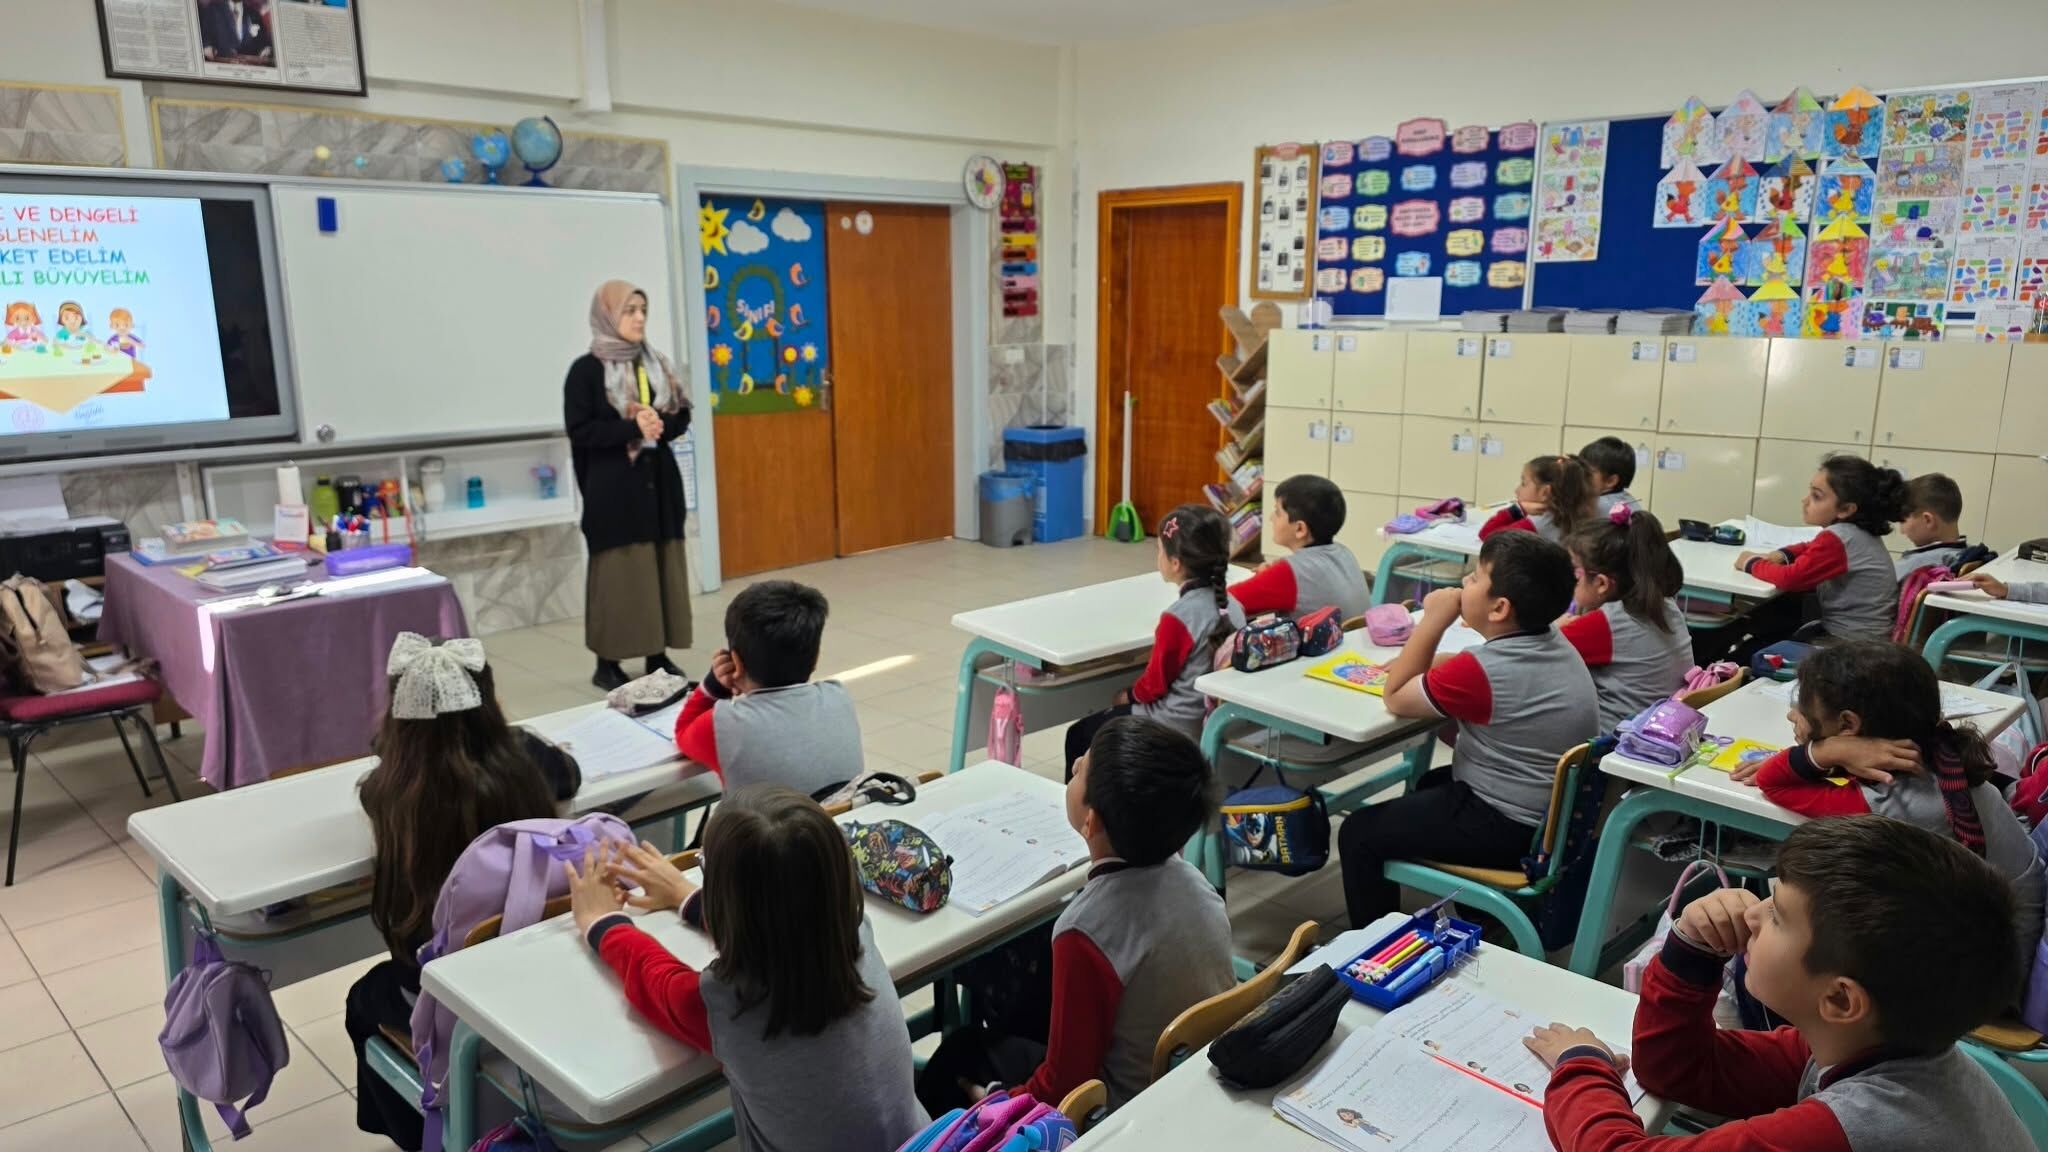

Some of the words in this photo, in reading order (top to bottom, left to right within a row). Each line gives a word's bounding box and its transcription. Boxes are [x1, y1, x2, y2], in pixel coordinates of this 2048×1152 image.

[14, 206, 41, 222] VE
[50, 205, 138, 222] DENGELİ
[48, 247, 126, 264] EDELİM
[33, 267, 149, 285] BÜYÜYELİM
[1275, 816, 1291, 864] BATMAN
